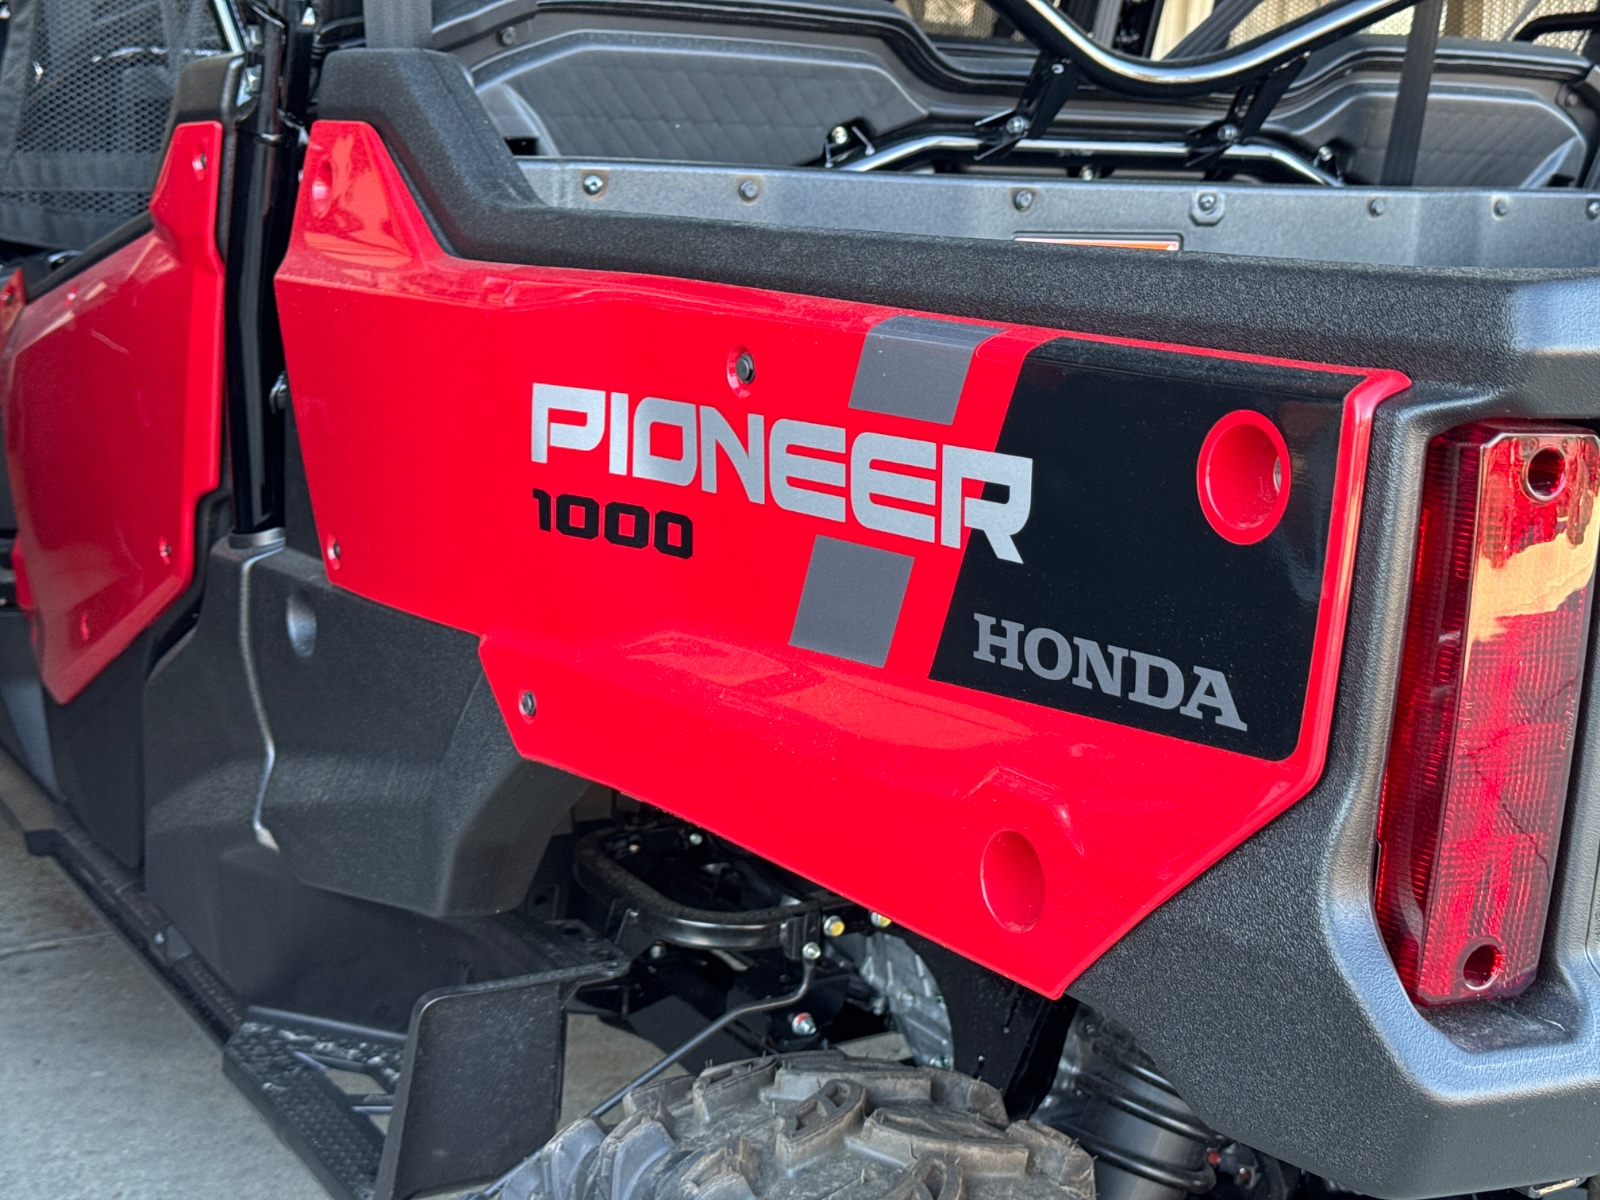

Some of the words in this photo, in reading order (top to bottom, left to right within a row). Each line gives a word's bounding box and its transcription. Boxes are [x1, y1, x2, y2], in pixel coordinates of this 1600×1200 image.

[531, 382, 1034, 565] PIONEER
[532, 487, 693, 560] 1000
[973, 612, 1248, 732] HONDA
